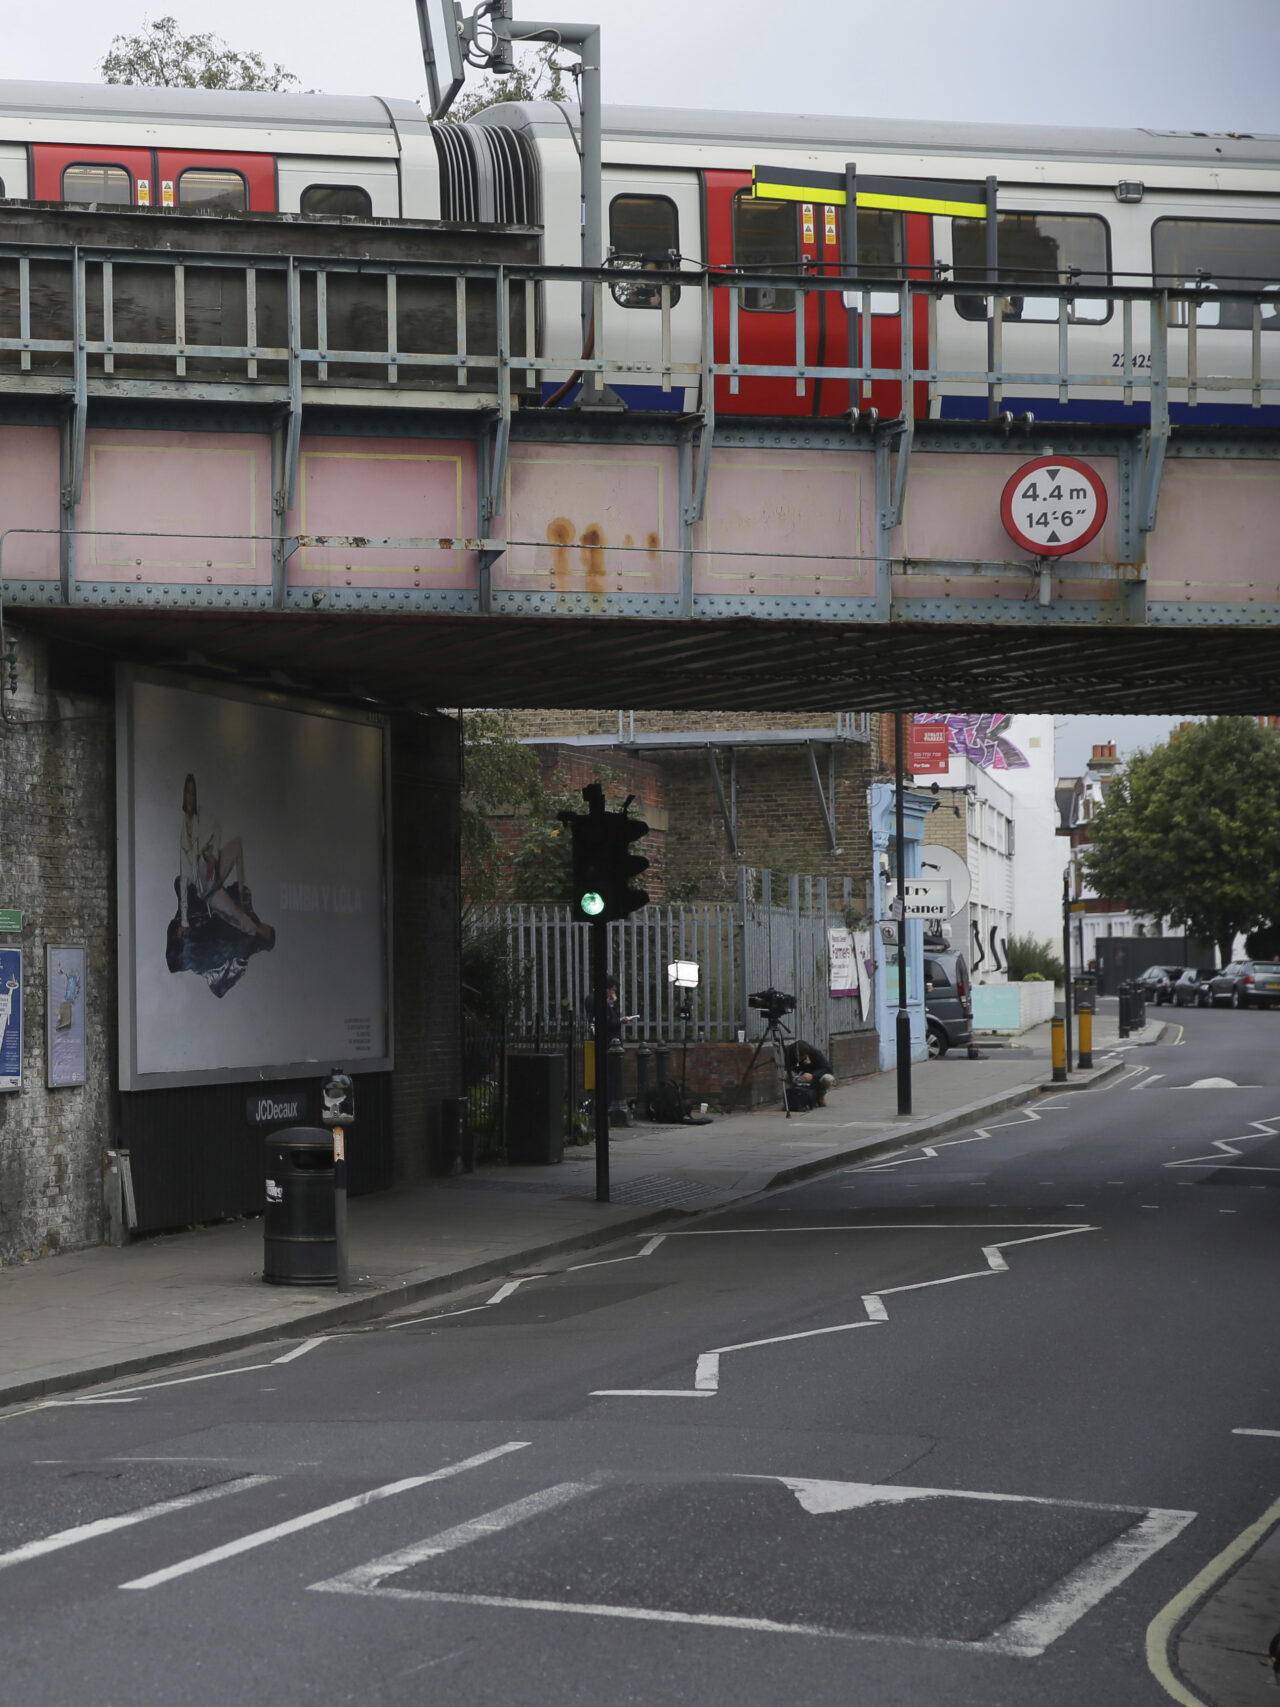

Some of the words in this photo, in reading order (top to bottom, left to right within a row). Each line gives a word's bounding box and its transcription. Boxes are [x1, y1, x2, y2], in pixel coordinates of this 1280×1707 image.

[1021, 482, 1064, 502] 4.4
[1069, 487, 1087, 500] m
[905, 886, 931, 896] Dry
[255, 1099, 298, 1121] JCDecaux
